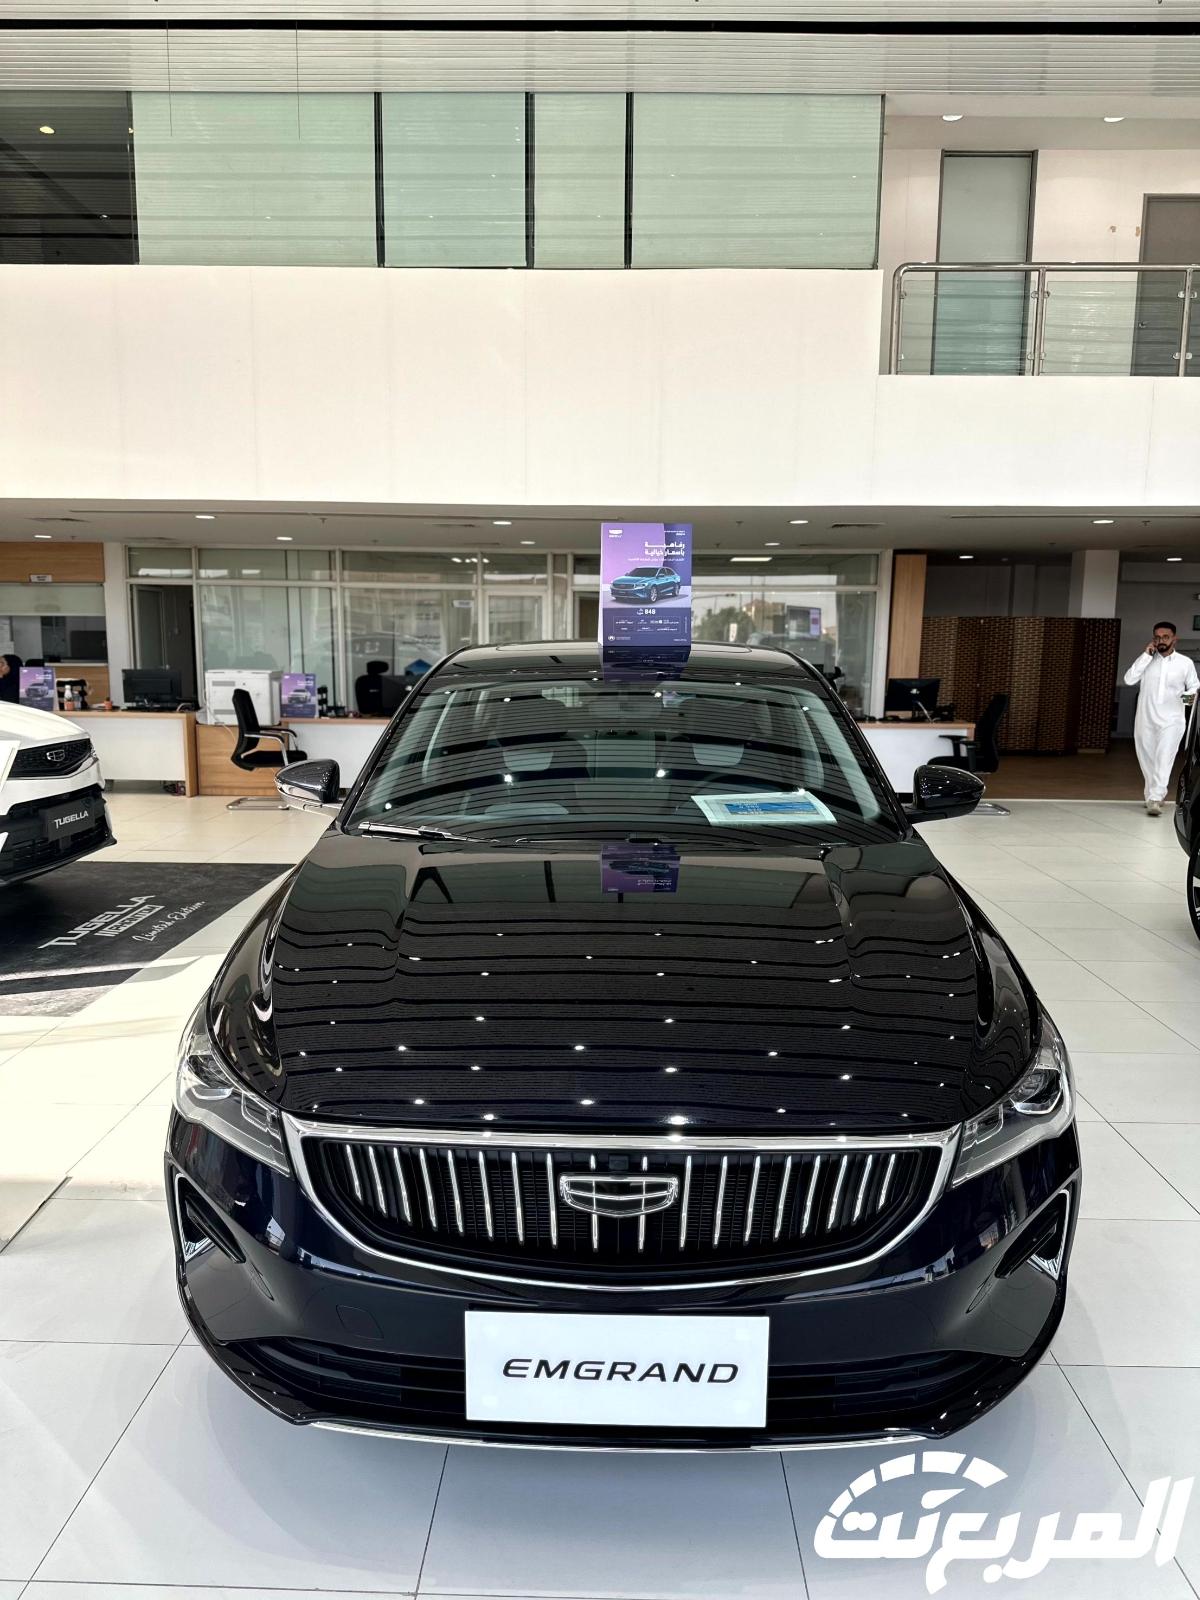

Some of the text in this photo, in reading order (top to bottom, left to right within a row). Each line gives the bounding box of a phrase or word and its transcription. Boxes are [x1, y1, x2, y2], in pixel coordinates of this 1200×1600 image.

[54, 810, 89, 829] TUGELLA
[37, 895, 156, 949] TUGELLA
[502, 1358, 739, 1384] EMGRAND
